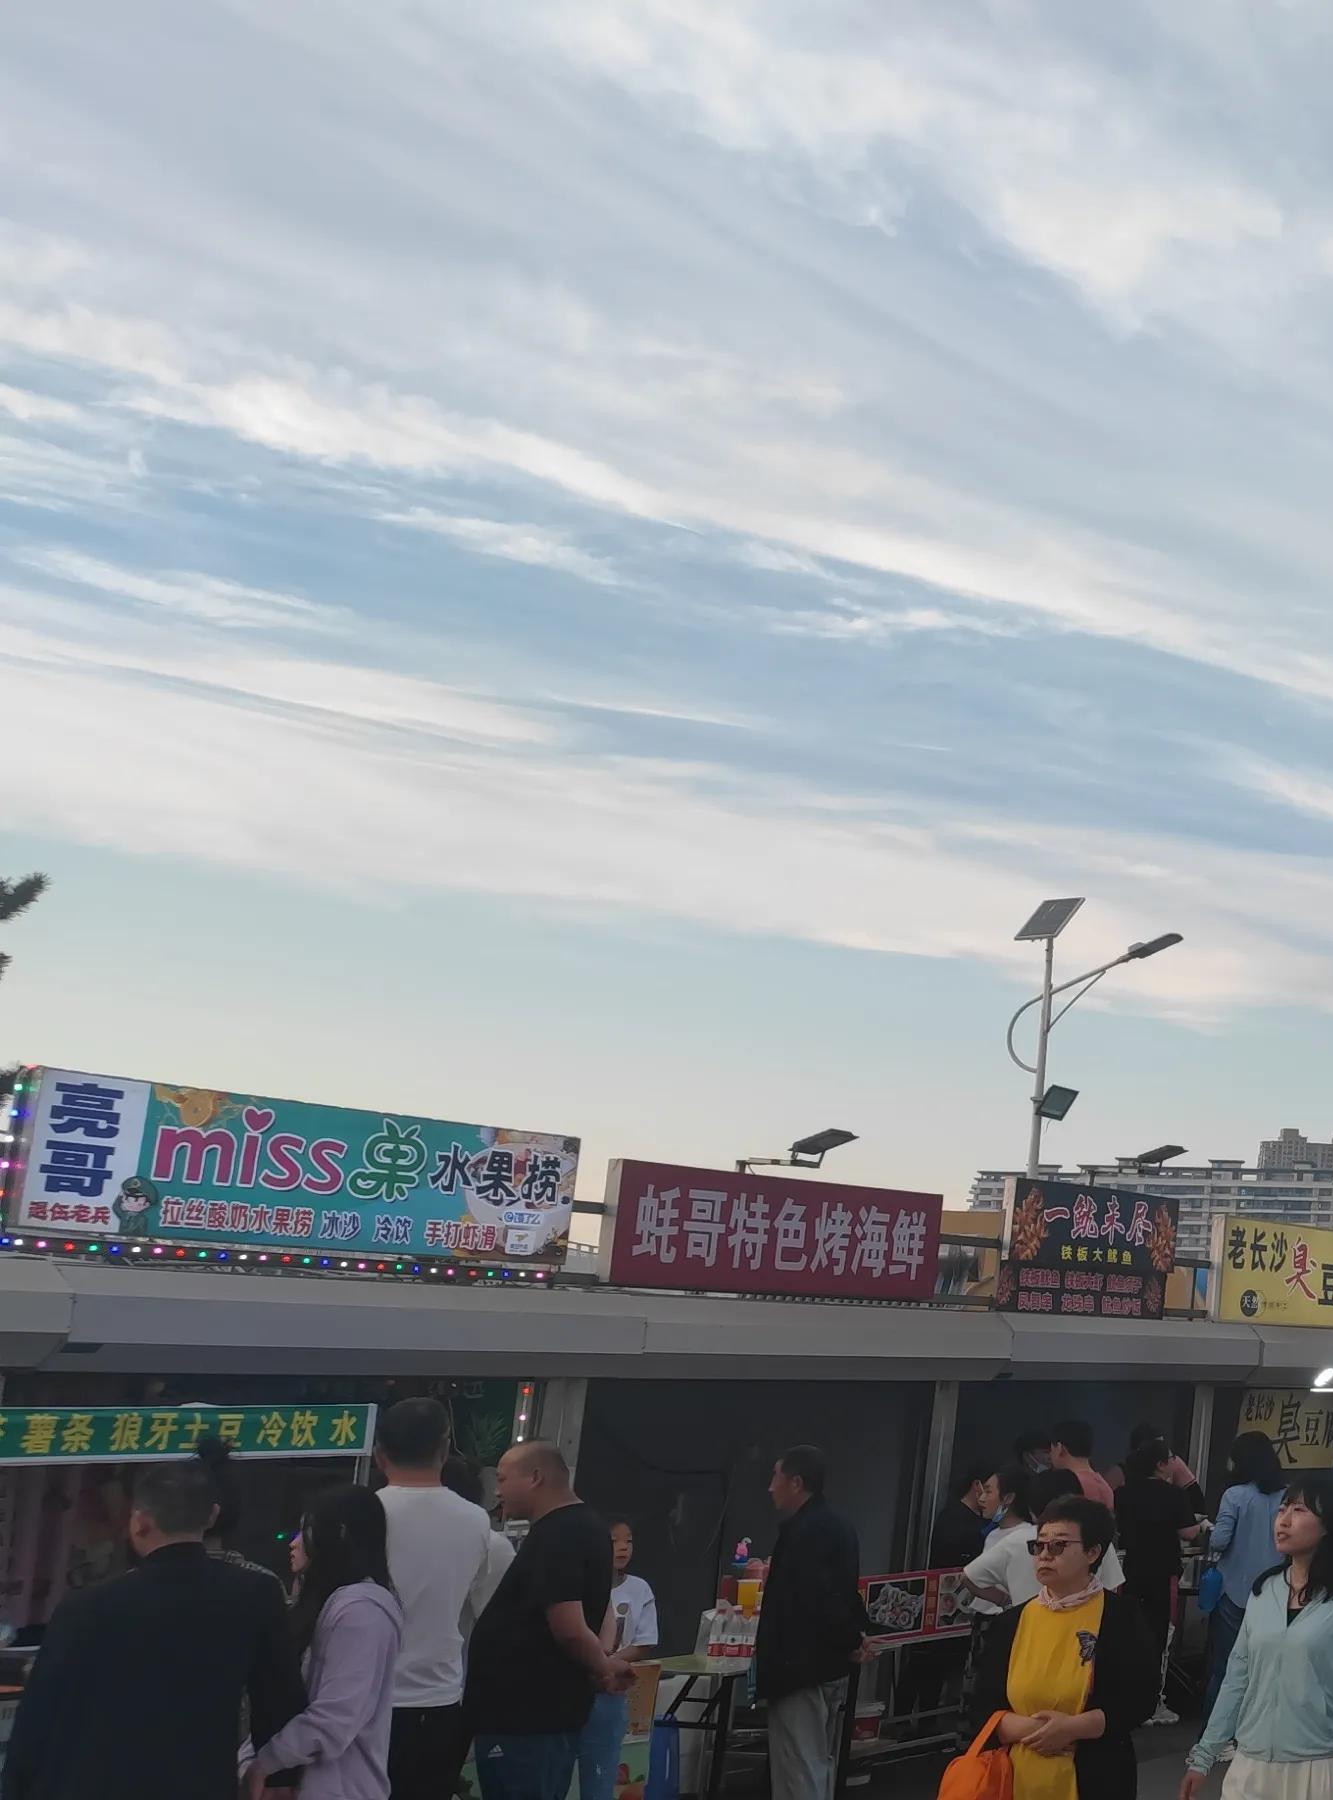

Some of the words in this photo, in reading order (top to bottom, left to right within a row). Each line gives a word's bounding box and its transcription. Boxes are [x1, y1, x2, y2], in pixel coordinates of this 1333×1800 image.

[40, 1082, 124, 1197] 亮哥
[428, 1146, 562, 1206] 水果捞
[28, 1200, 112, 1226] 退伍老兵
[160, 1196, 315, 1239] 拉丝酸奶水果捞
[318, 1207, 362, 1240] 冰沙
[371, 1214, 414, 1245] 冷饮
[424, 1220, 498, 1252] 手打虾滑
[631, 1183, 928, 1281] 蚝哥特色烤海鲜
[19, 1412, 95, 1454] 薯条
[109, 1413, 245, 1452] 狼牙土豆
[255, 1410, 321, 1448] 冷饮
[329, 1409, 358, 1450] 水
